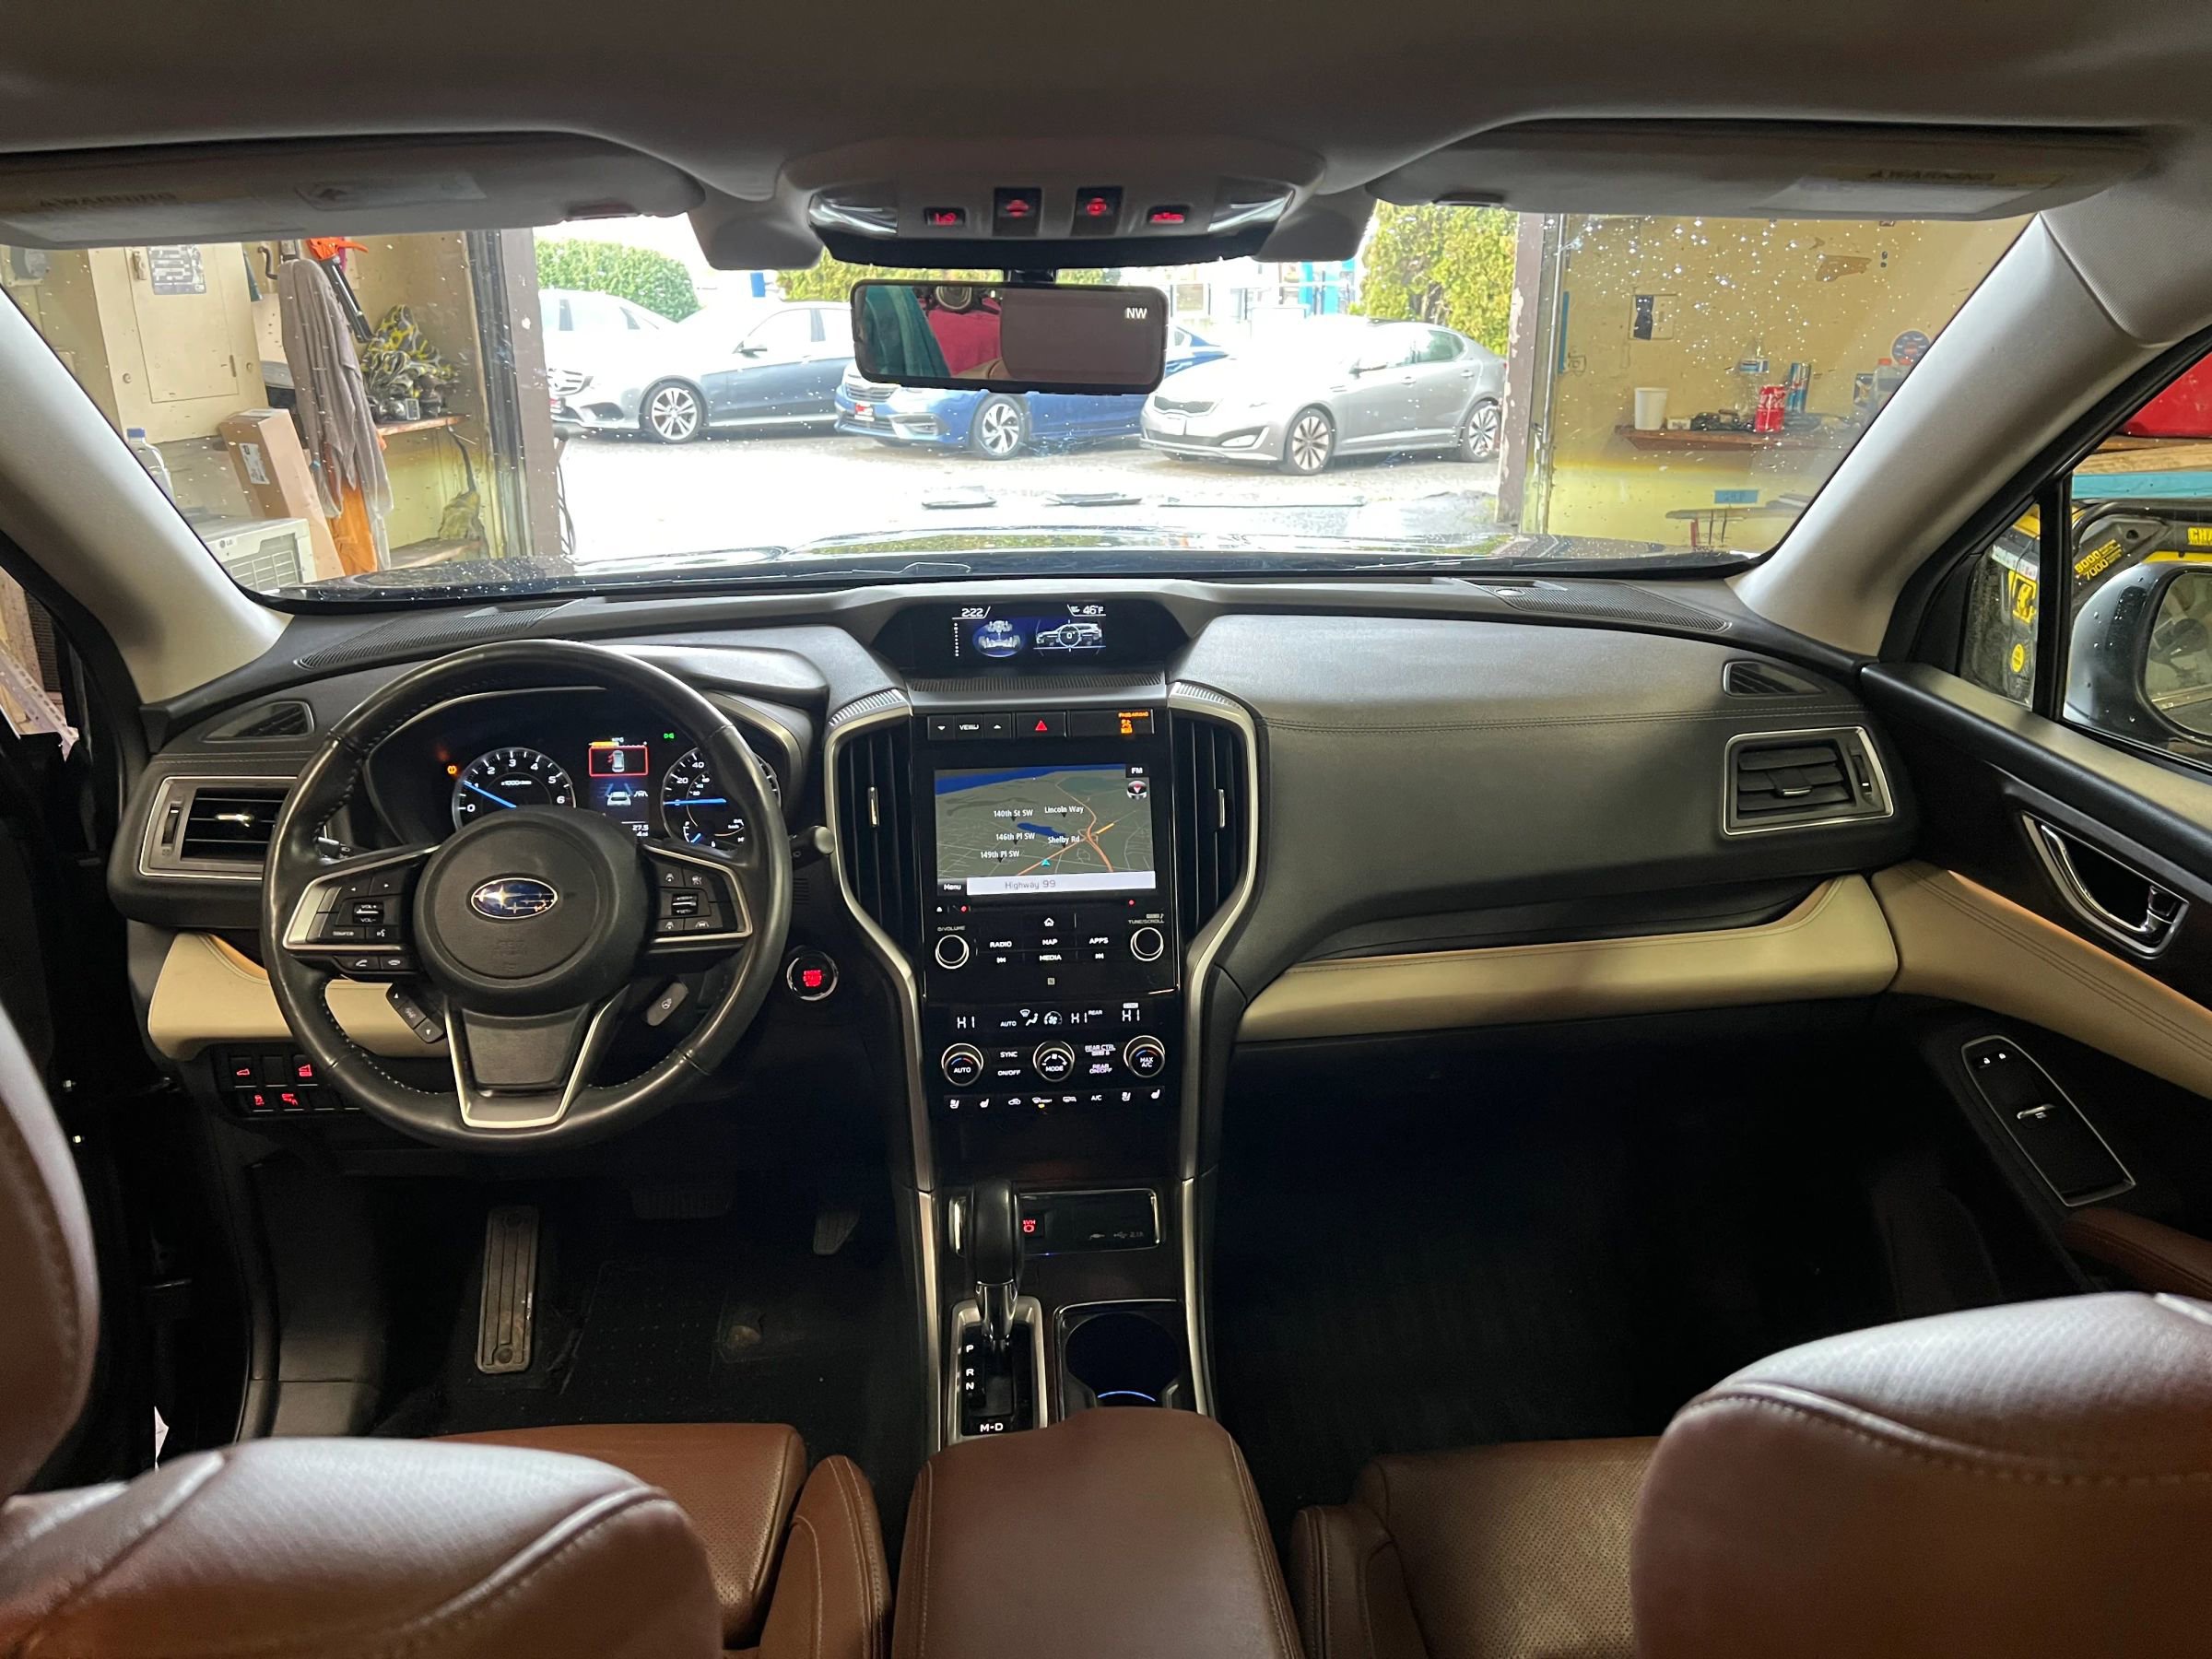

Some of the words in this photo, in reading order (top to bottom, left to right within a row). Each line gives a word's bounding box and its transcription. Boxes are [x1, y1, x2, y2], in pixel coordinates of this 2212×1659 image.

[1125, 307, 1147, 319] NW
[2075, 550, 2101, 572] 9000
[2084, 559, 2109, 581] 7000
[961, 607, 984, 618] 2:22
[487, 766, 496, 775] 2
[547, 776, 557, 784] 5
[556, 795, 565, 804] 6
[466, 804, 476, 813] 0
[1044, 805, 1067, 814] Lincoln
[1068, 806, 1084, 815] Way
[994, 809, 1013, 818] 140th
[1014, 809, 1021, 818] St
[1022, 809, 1033, 818] SW
[995, 832, 1015, 841] 146th
[1048, 836, 1070, 845] Shelby
[1071, 835, 1080, 843] Rd
[980, 851, 999, 859] 149th
[1000, 850, 1007, 858] Pl
[1008, 850, 1019, 858] SW
[943, 883, 961, 891] Menu
[1005, 881, 1040, 890] Highway
[1042, 879, 1056, 888] 99
[989, 940, 1012, 948] RADIO
[1088, 936, 1109, 945] APPS
[1039, 953, 1062, 961] MEDIA
[1071, 1012, 1088, 1024] HI
[1123, 1009, 1140, 1022] HI
[957, 1016, 975, 1030] HI
[966, 1344, 974, 1353] P
[966, 1368, 974, 1376] R
[966, 1382, 974, 1391] N
